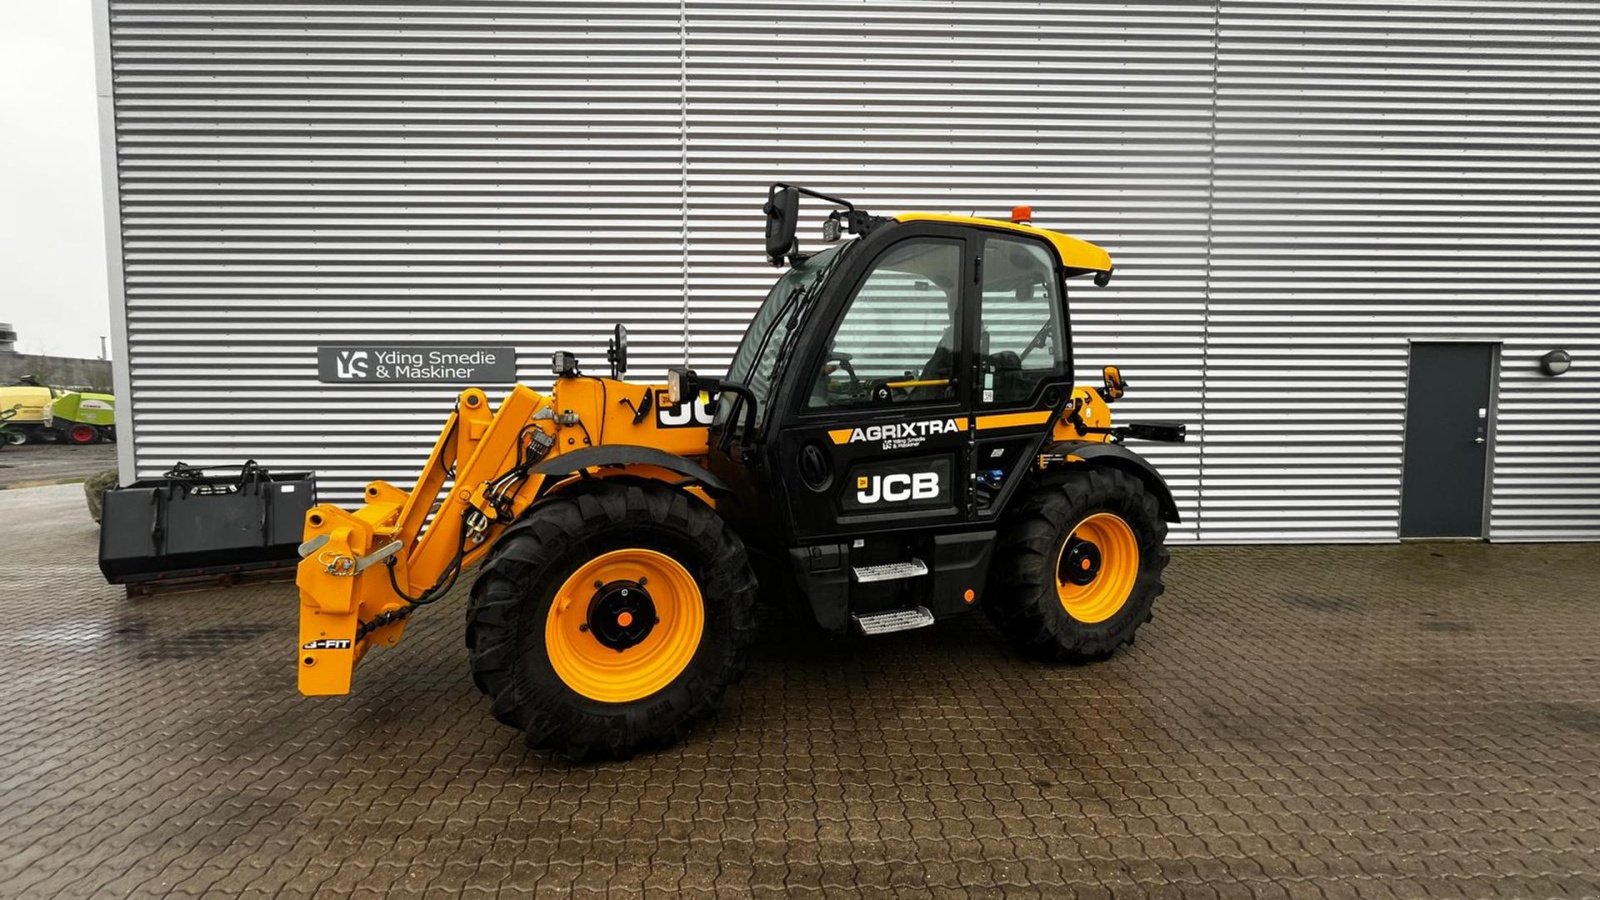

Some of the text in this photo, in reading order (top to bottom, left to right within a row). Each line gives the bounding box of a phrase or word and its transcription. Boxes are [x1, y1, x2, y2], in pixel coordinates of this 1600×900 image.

[375, 351, 496, 367] Yding Smedie
[376, 366, 475, 378] & Maskiner
[850, 419, 958, 443] AGRIXTRA
[857, 472, 940, 504] JCB
